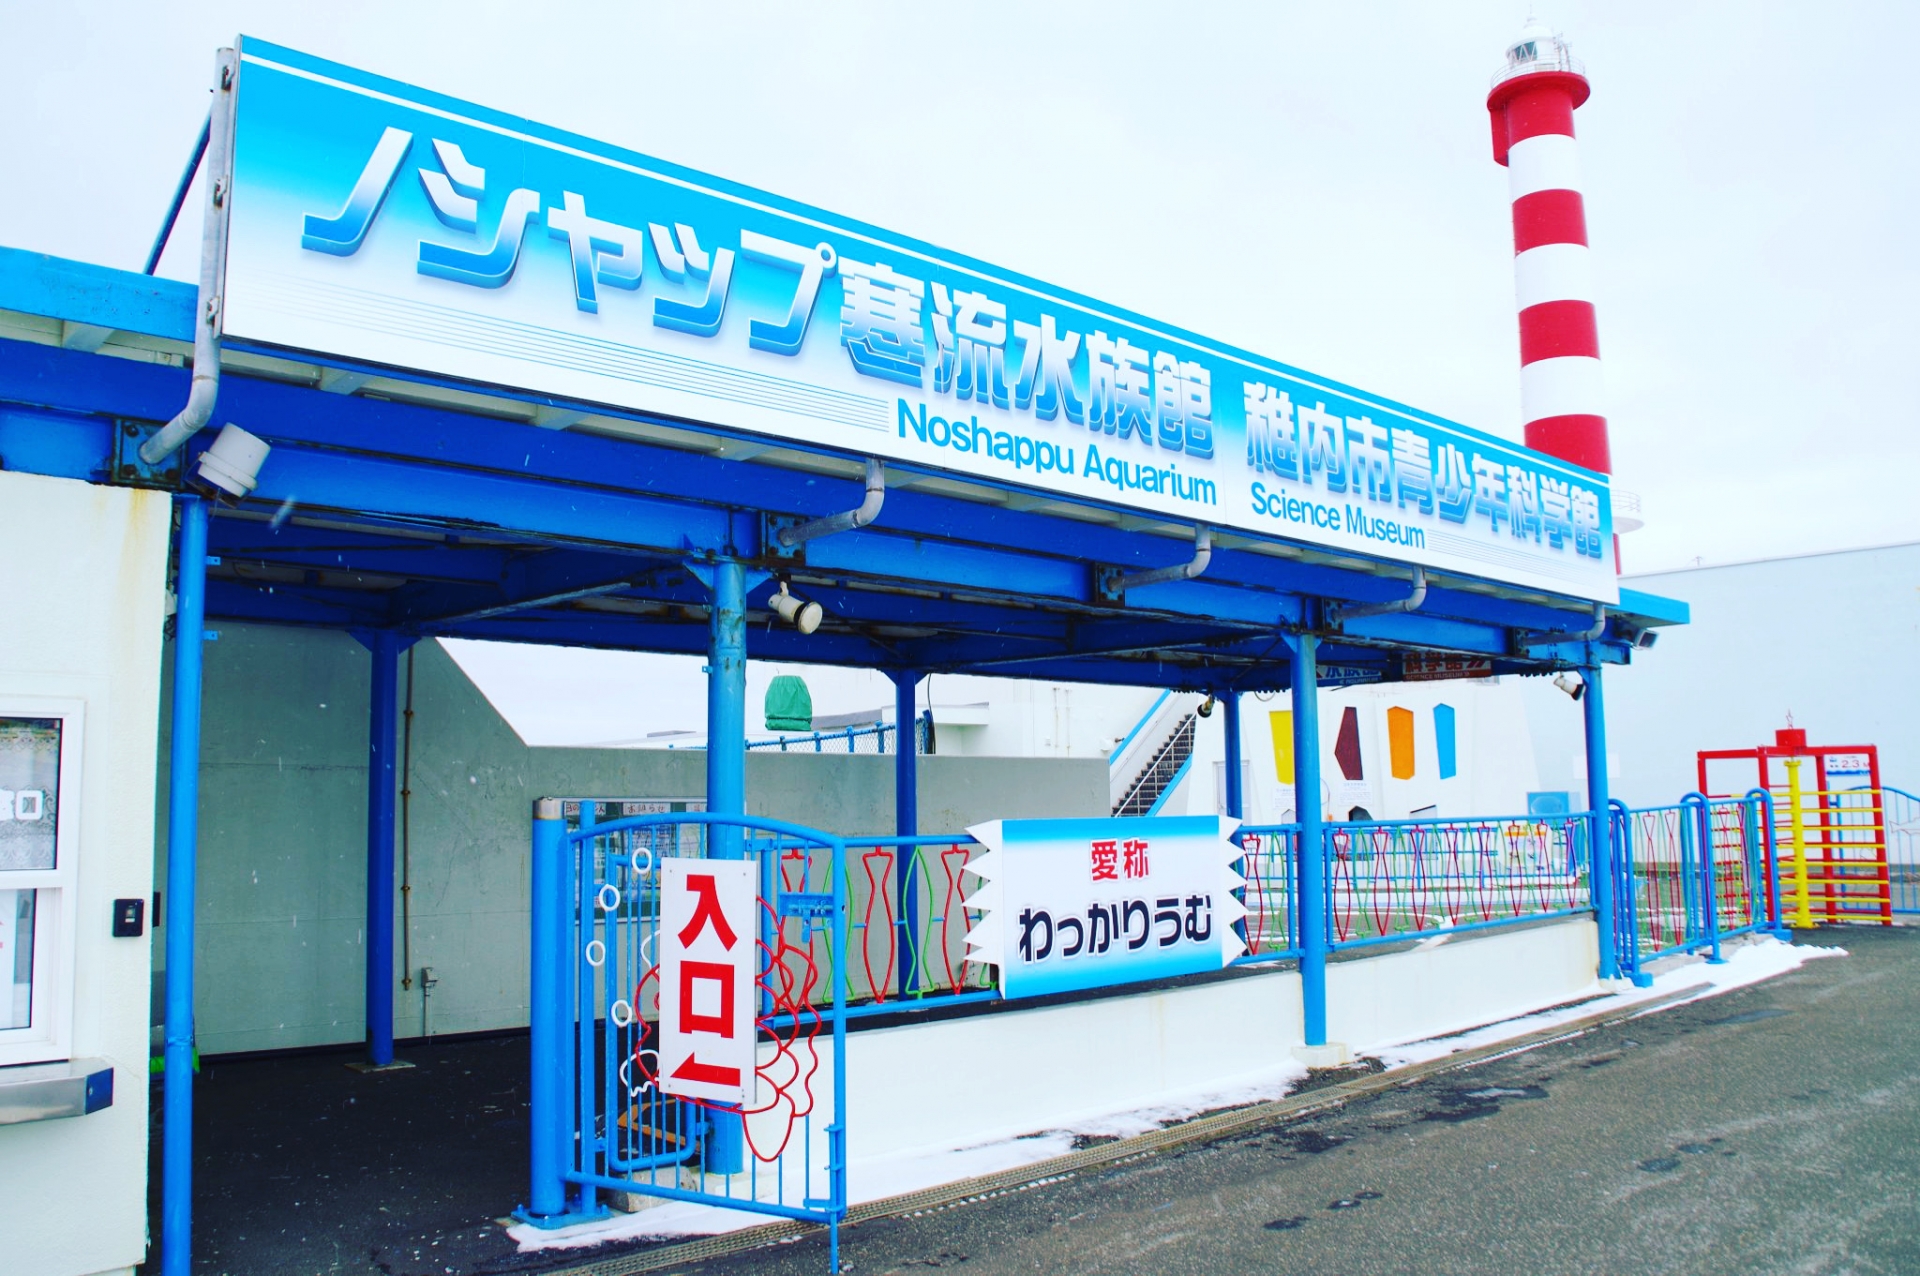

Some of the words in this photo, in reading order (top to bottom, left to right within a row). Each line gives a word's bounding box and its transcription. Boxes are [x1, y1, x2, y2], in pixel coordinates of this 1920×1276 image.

[898, 398, 1075, 475] Noshappu
[1083, 443, 1217, 506] Aquarium
[1243, 381, 1602, 559] 稚内市青少年科学館
[1251, 480, 1341, 530] Science
[1346, 505, 1425, 549] Museum
[1090, 838, 1151, 882] 愛称
[677, 873, 739, 1039] 入口
[1018, 894, 1212, 963] わっかりうむ
